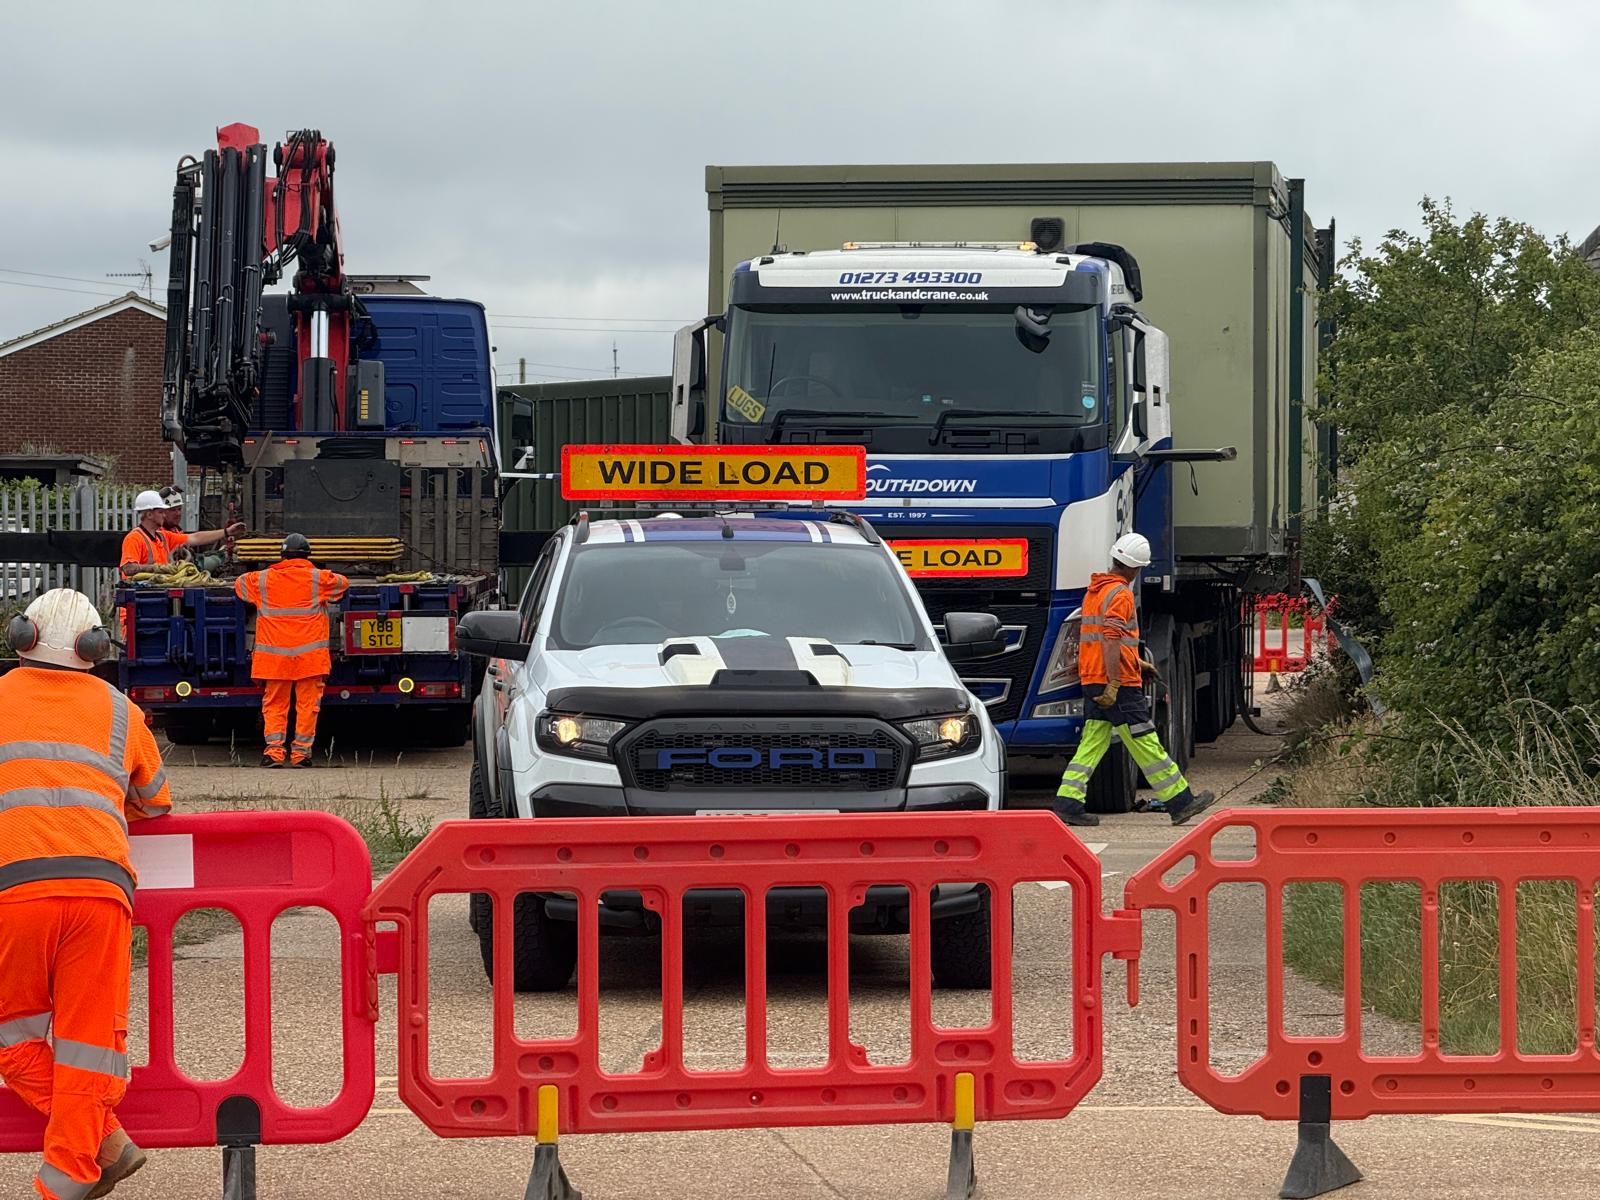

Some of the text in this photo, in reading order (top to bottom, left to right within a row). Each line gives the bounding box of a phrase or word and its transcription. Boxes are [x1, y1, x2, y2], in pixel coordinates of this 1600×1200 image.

[839, 271, 983, 284] 01273 493300
[831, 289, 989, 301] www.truckandcrane.co.uk
[728, 388, 761, 418] LUGS
[598, 460, 830, 485] WIDE LOAD
[866, 479, 977, 492] OUTHDOWN
[923, 549, 1003, 567] LOAD
[368, 620, 394, 633] Y88
[368, 634, 394, 647] STC
[674, 722, 858, 731] RANGER
[657, 747, 877, 769] FORD
